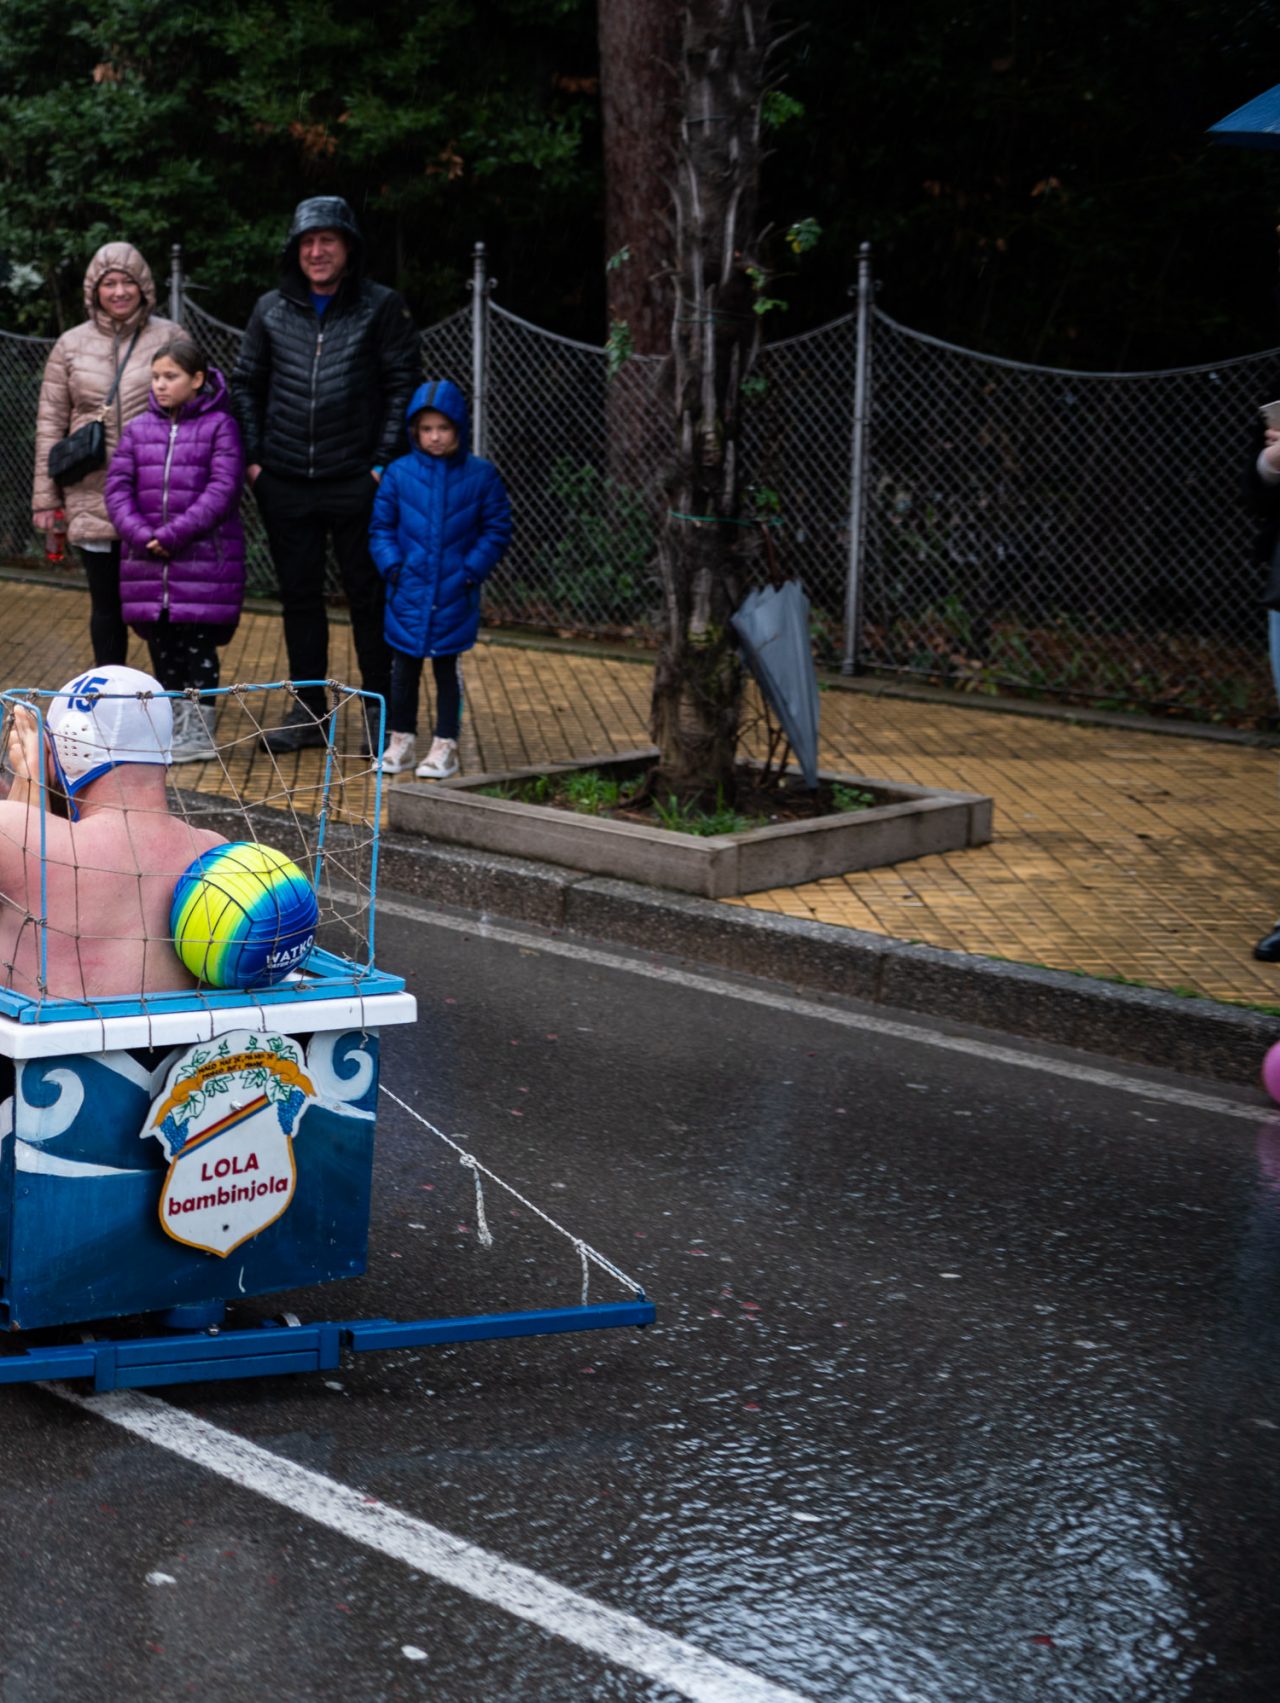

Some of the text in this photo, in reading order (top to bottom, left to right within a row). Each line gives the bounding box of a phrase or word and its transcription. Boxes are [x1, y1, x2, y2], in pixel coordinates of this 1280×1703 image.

[67, 675, 110, 713] 15
[201, 1152, 259, 1182] LOLA
[168, 1175, 288, 1217] bambinjola
